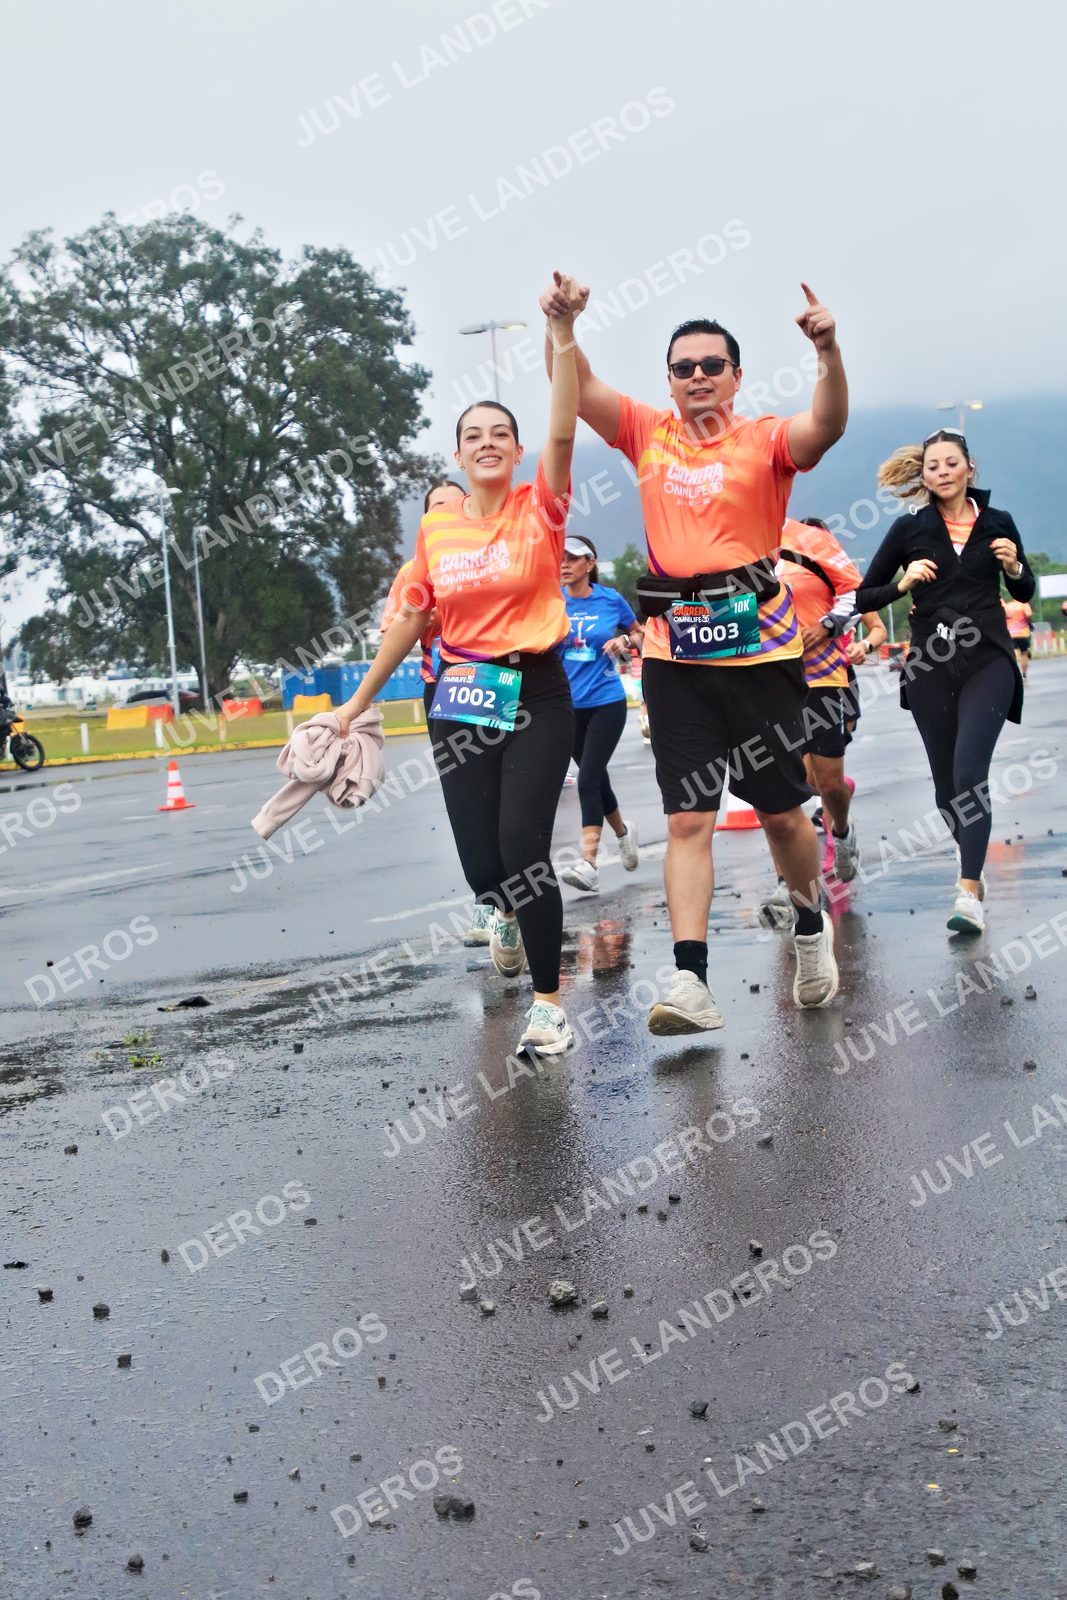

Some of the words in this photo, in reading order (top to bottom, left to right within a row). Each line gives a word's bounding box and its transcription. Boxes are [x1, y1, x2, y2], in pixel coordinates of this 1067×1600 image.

[672, 605, 711, 617] CARRERA
[734, 599, 750, 614] 10K
[687, 622, 739, 644] 1003
[497, 671, 515, 686] 10K
[448, 686, 497, 709] 1002
